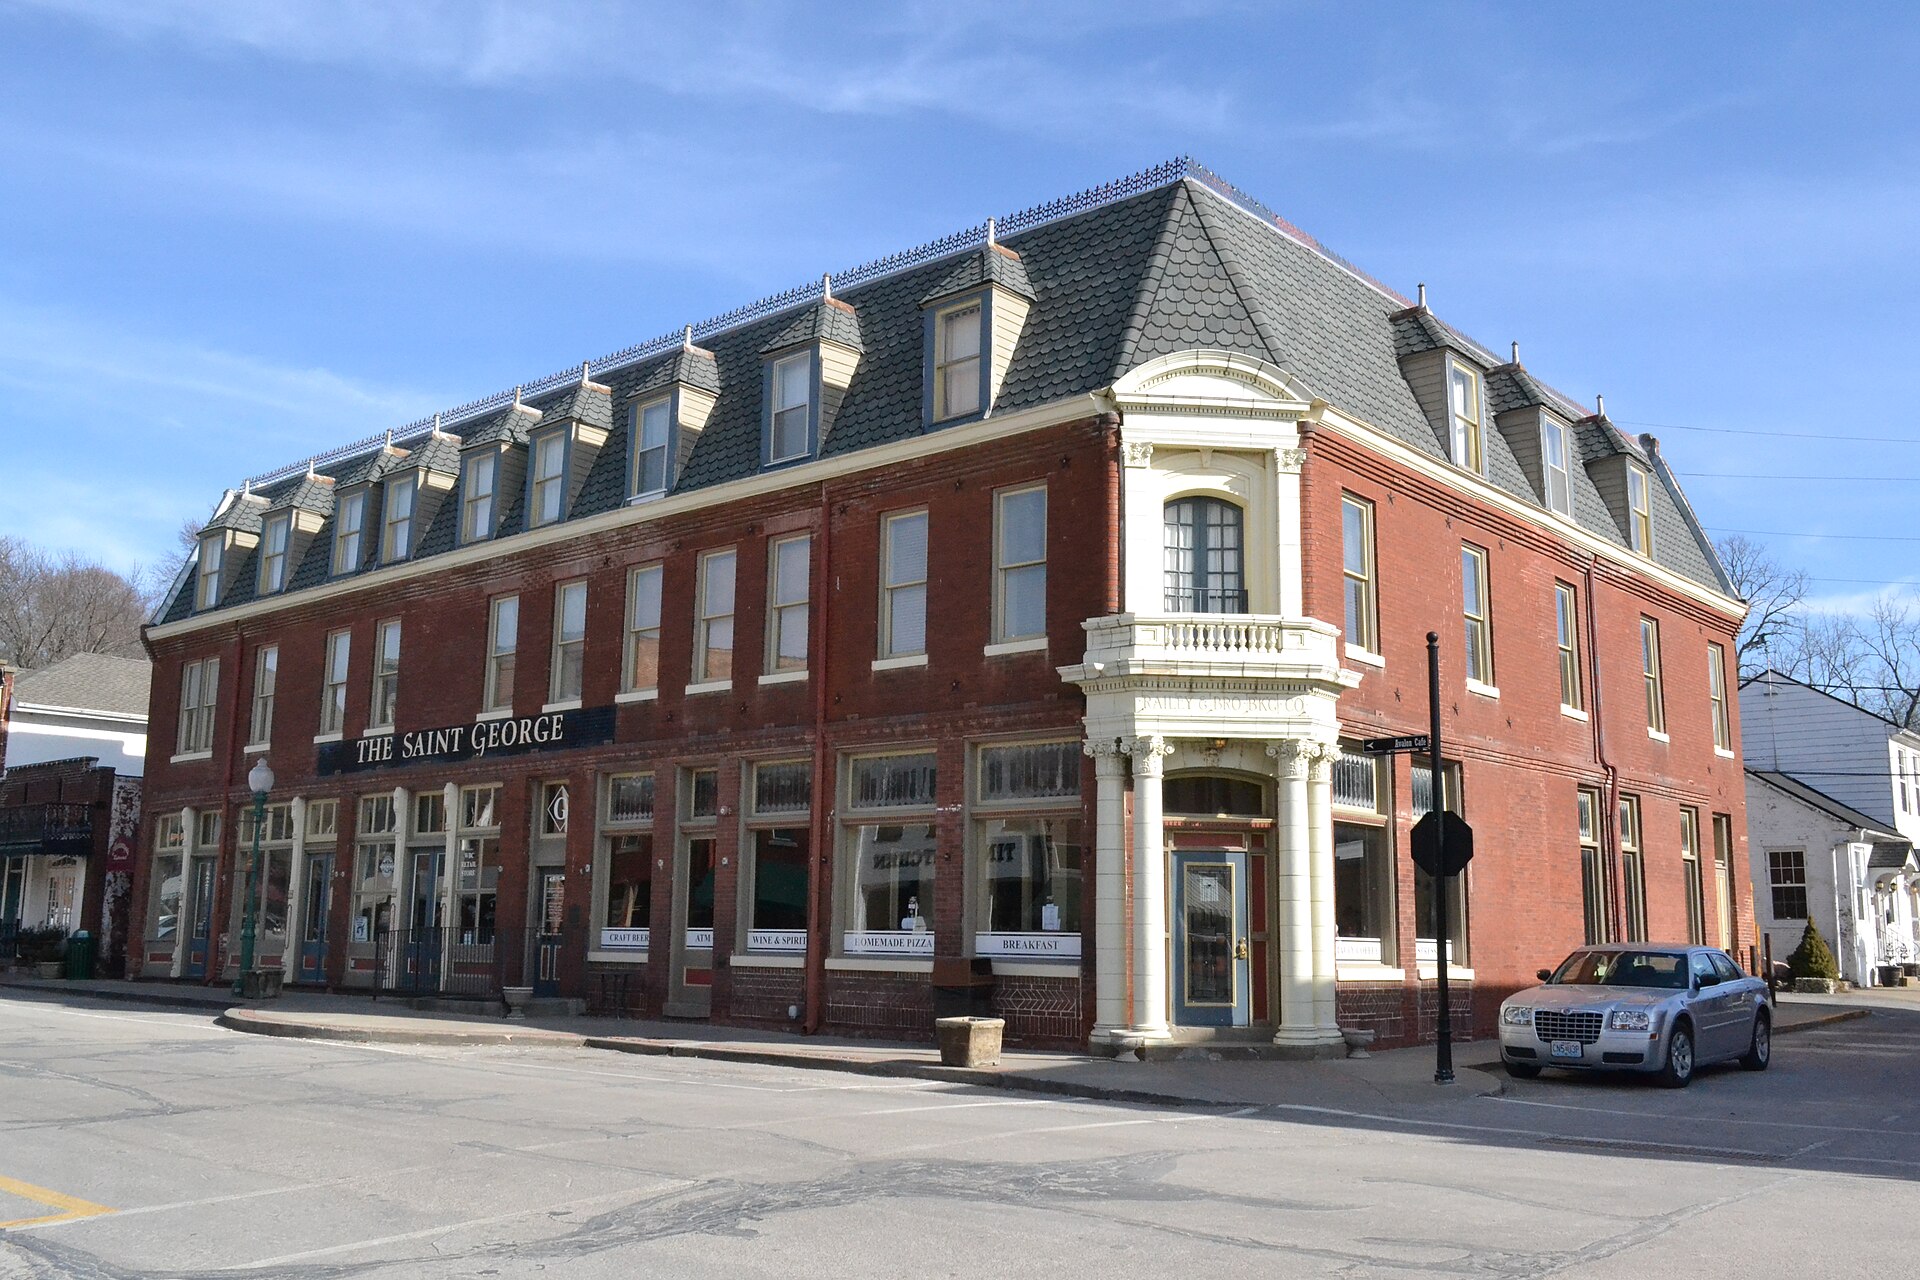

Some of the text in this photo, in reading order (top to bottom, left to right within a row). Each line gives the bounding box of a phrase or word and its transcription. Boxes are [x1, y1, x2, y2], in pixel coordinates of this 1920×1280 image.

[1142, 695, 1191, 710] RAILEY
[357, 714, 564, 763] THE SAINT GEORGE
[1394, 739, 1412, 748] Avalon
[553, 797, 567, 820] G
[609, 934, 649, 942] CRAFT BEER
[695, 934, 711, 943] ATM
[752, 935, 773, 945] WINE
[774, 936, 780, 945] &
[907, 938, 932, 948] PIZZA
[1003, 940, 1059, 950] BREAKFAST
